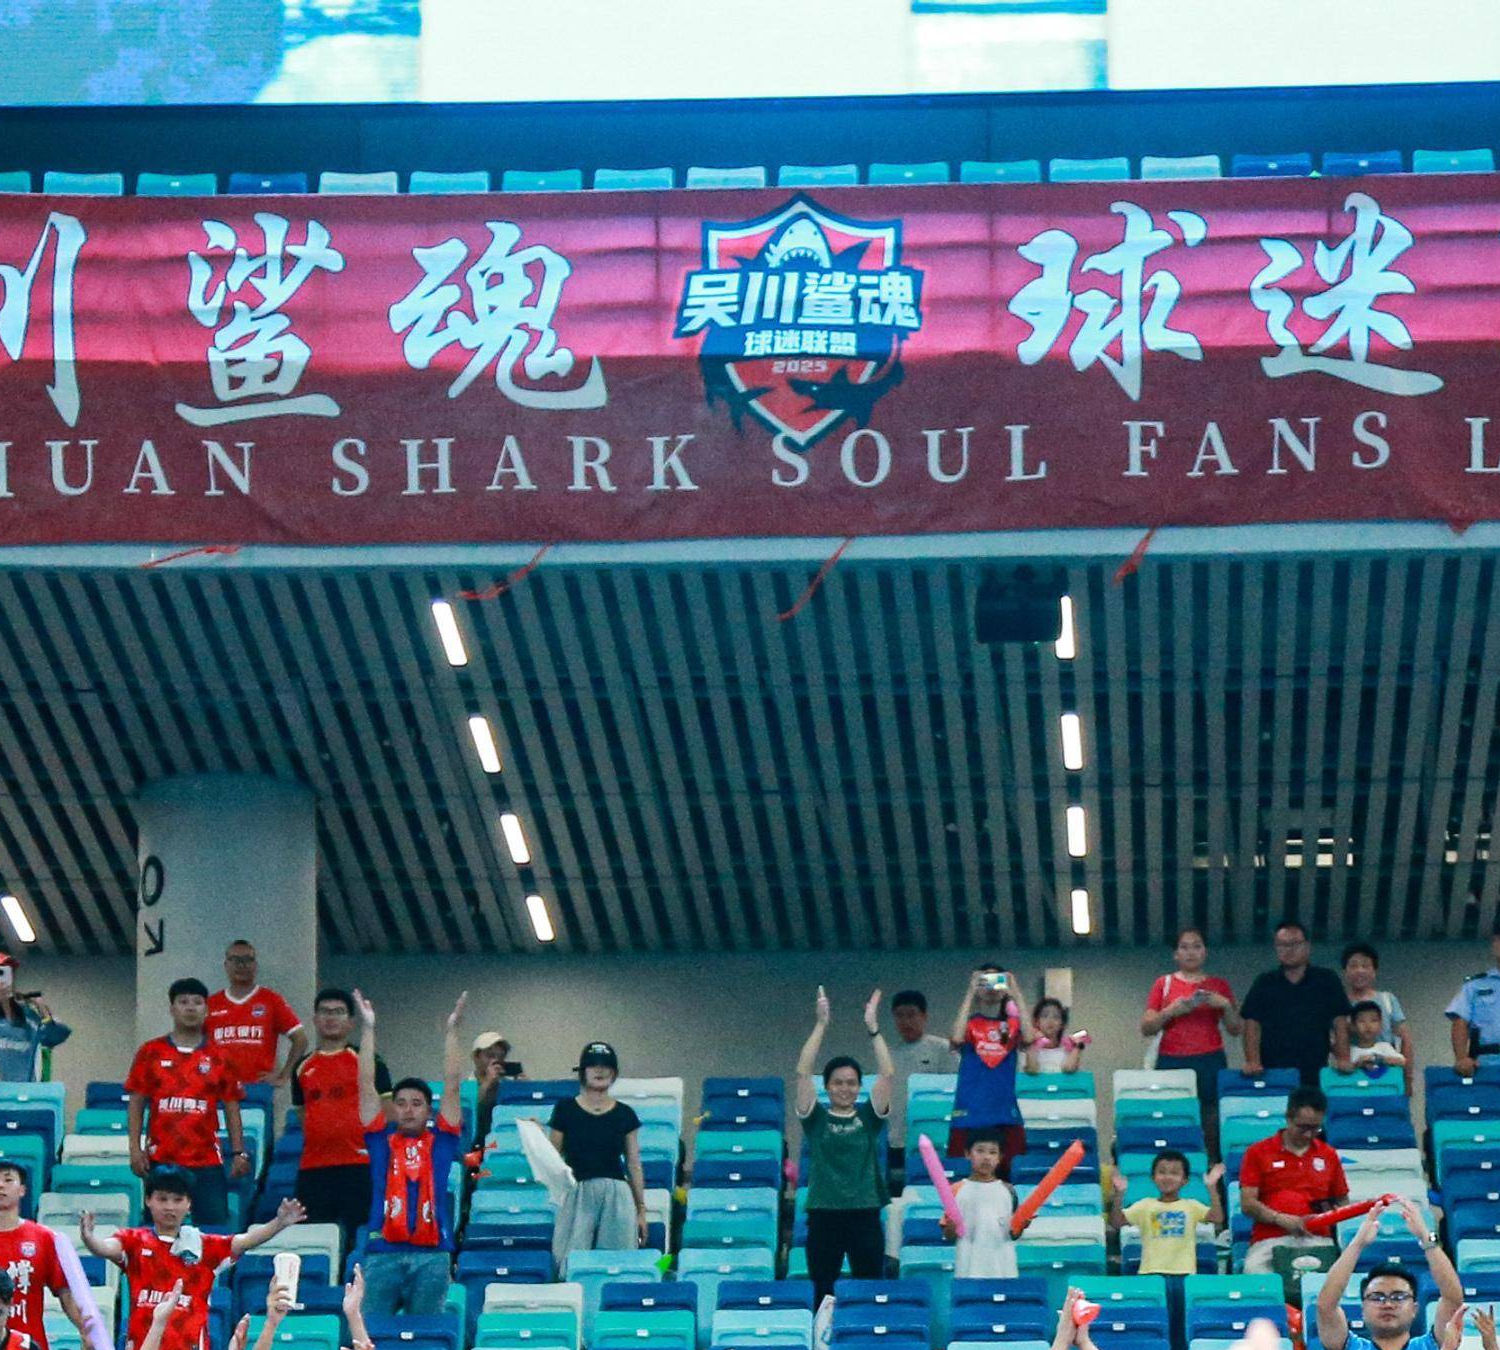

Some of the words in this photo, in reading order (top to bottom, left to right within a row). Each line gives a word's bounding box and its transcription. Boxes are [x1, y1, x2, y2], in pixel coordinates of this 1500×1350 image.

[682, 270, 920, 333] 吴川鲨魂
[743, 330, 857, 356] 球迷联盟
[771, 360, 828, 374] 2025
[330, 433, 701, 495] SHARK
[770, 427, 1048, 485] SOUL
[1124, 411, 1392, 478] FANS
